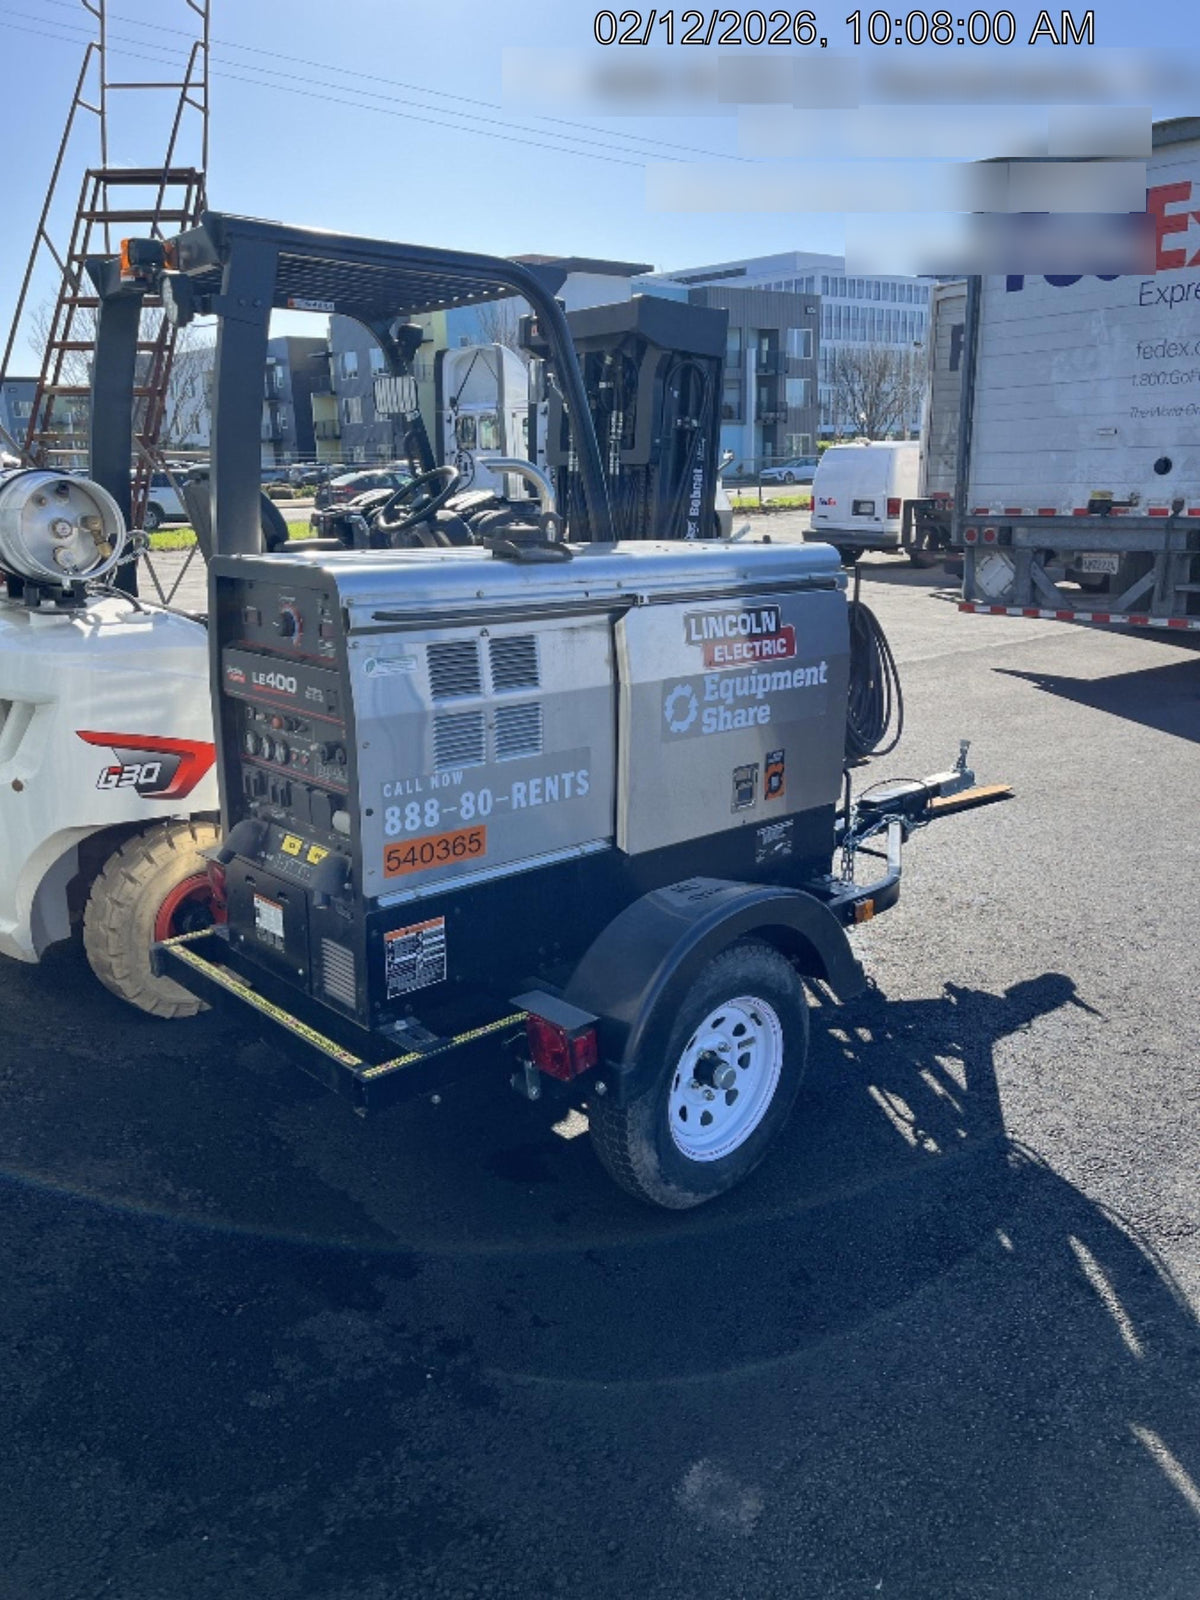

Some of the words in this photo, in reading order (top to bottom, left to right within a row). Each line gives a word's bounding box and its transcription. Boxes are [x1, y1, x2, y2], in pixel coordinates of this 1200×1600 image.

[690, 611, 777, 641] LINCOLN
[714, 637, 788, 663] ELECTRIC
[251, 671, 298, 695] LE400
[703, 660, 829, 705] Equipment
[702, 703, 771, 735] Share
[96, 761, 162, 790] G30
[383, 777, 423, 799] CALL
[430, 770, 464, 790] NOW
[384, 769, 590, 837] 888-80-RENTS
[386, 831, 483, 873] 540365
